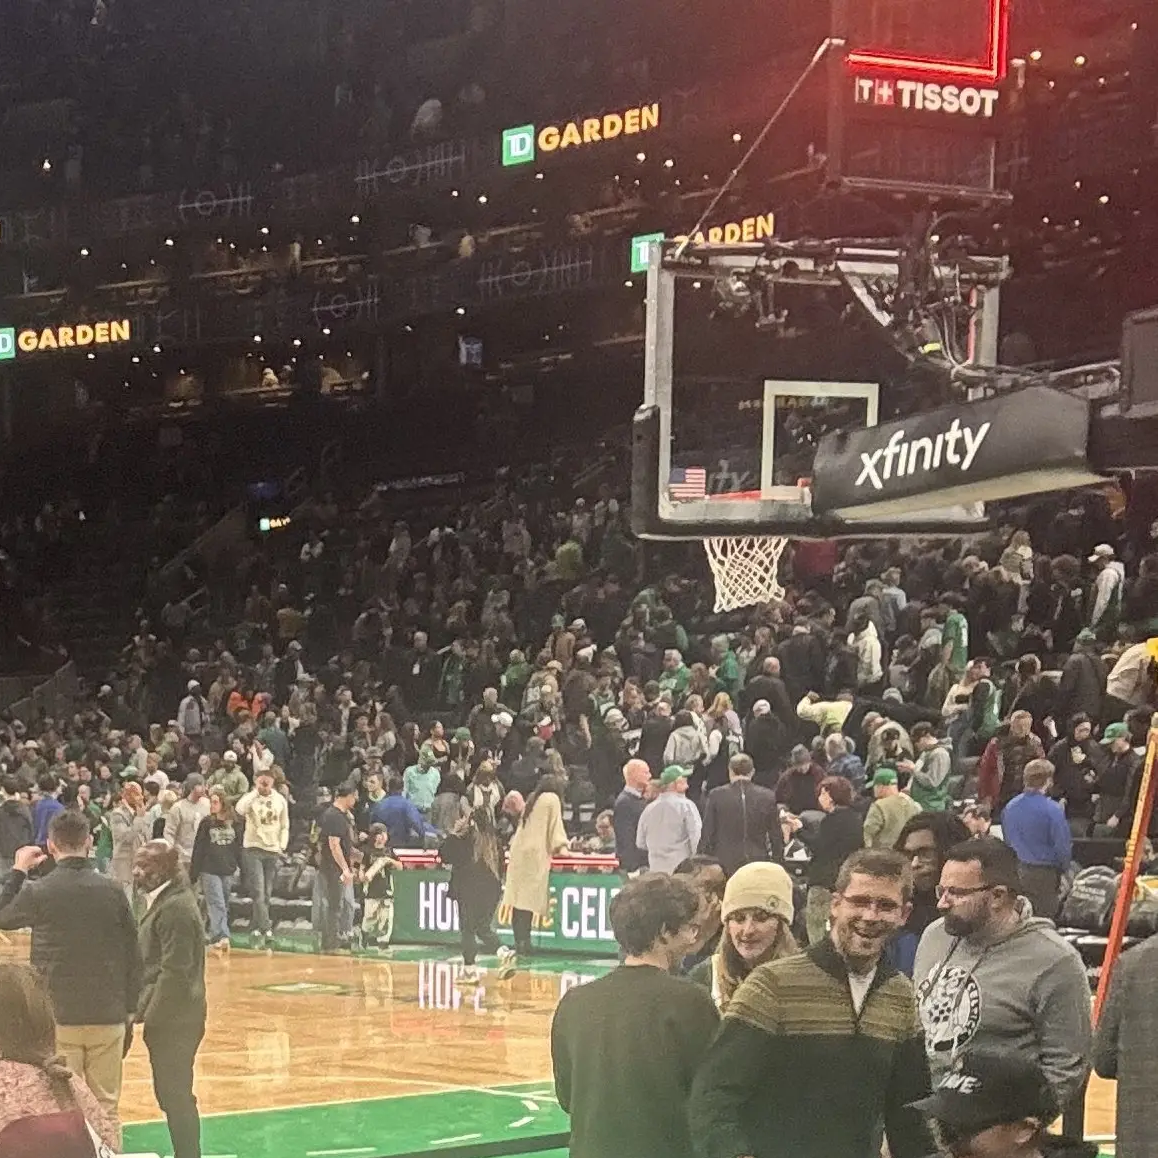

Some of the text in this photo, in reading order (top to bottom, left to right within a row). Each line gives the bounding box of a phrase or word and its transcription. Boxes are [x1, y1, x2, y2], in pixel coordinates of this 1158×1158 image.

[896, 79, 999, 117] TISSOT
[538, 103, 659, 151] GARDEN
[18, 320, 130, 352] GARDEN
[855, 418, 990, 490] xfinity
[562, 887, 619, 940] CEL
